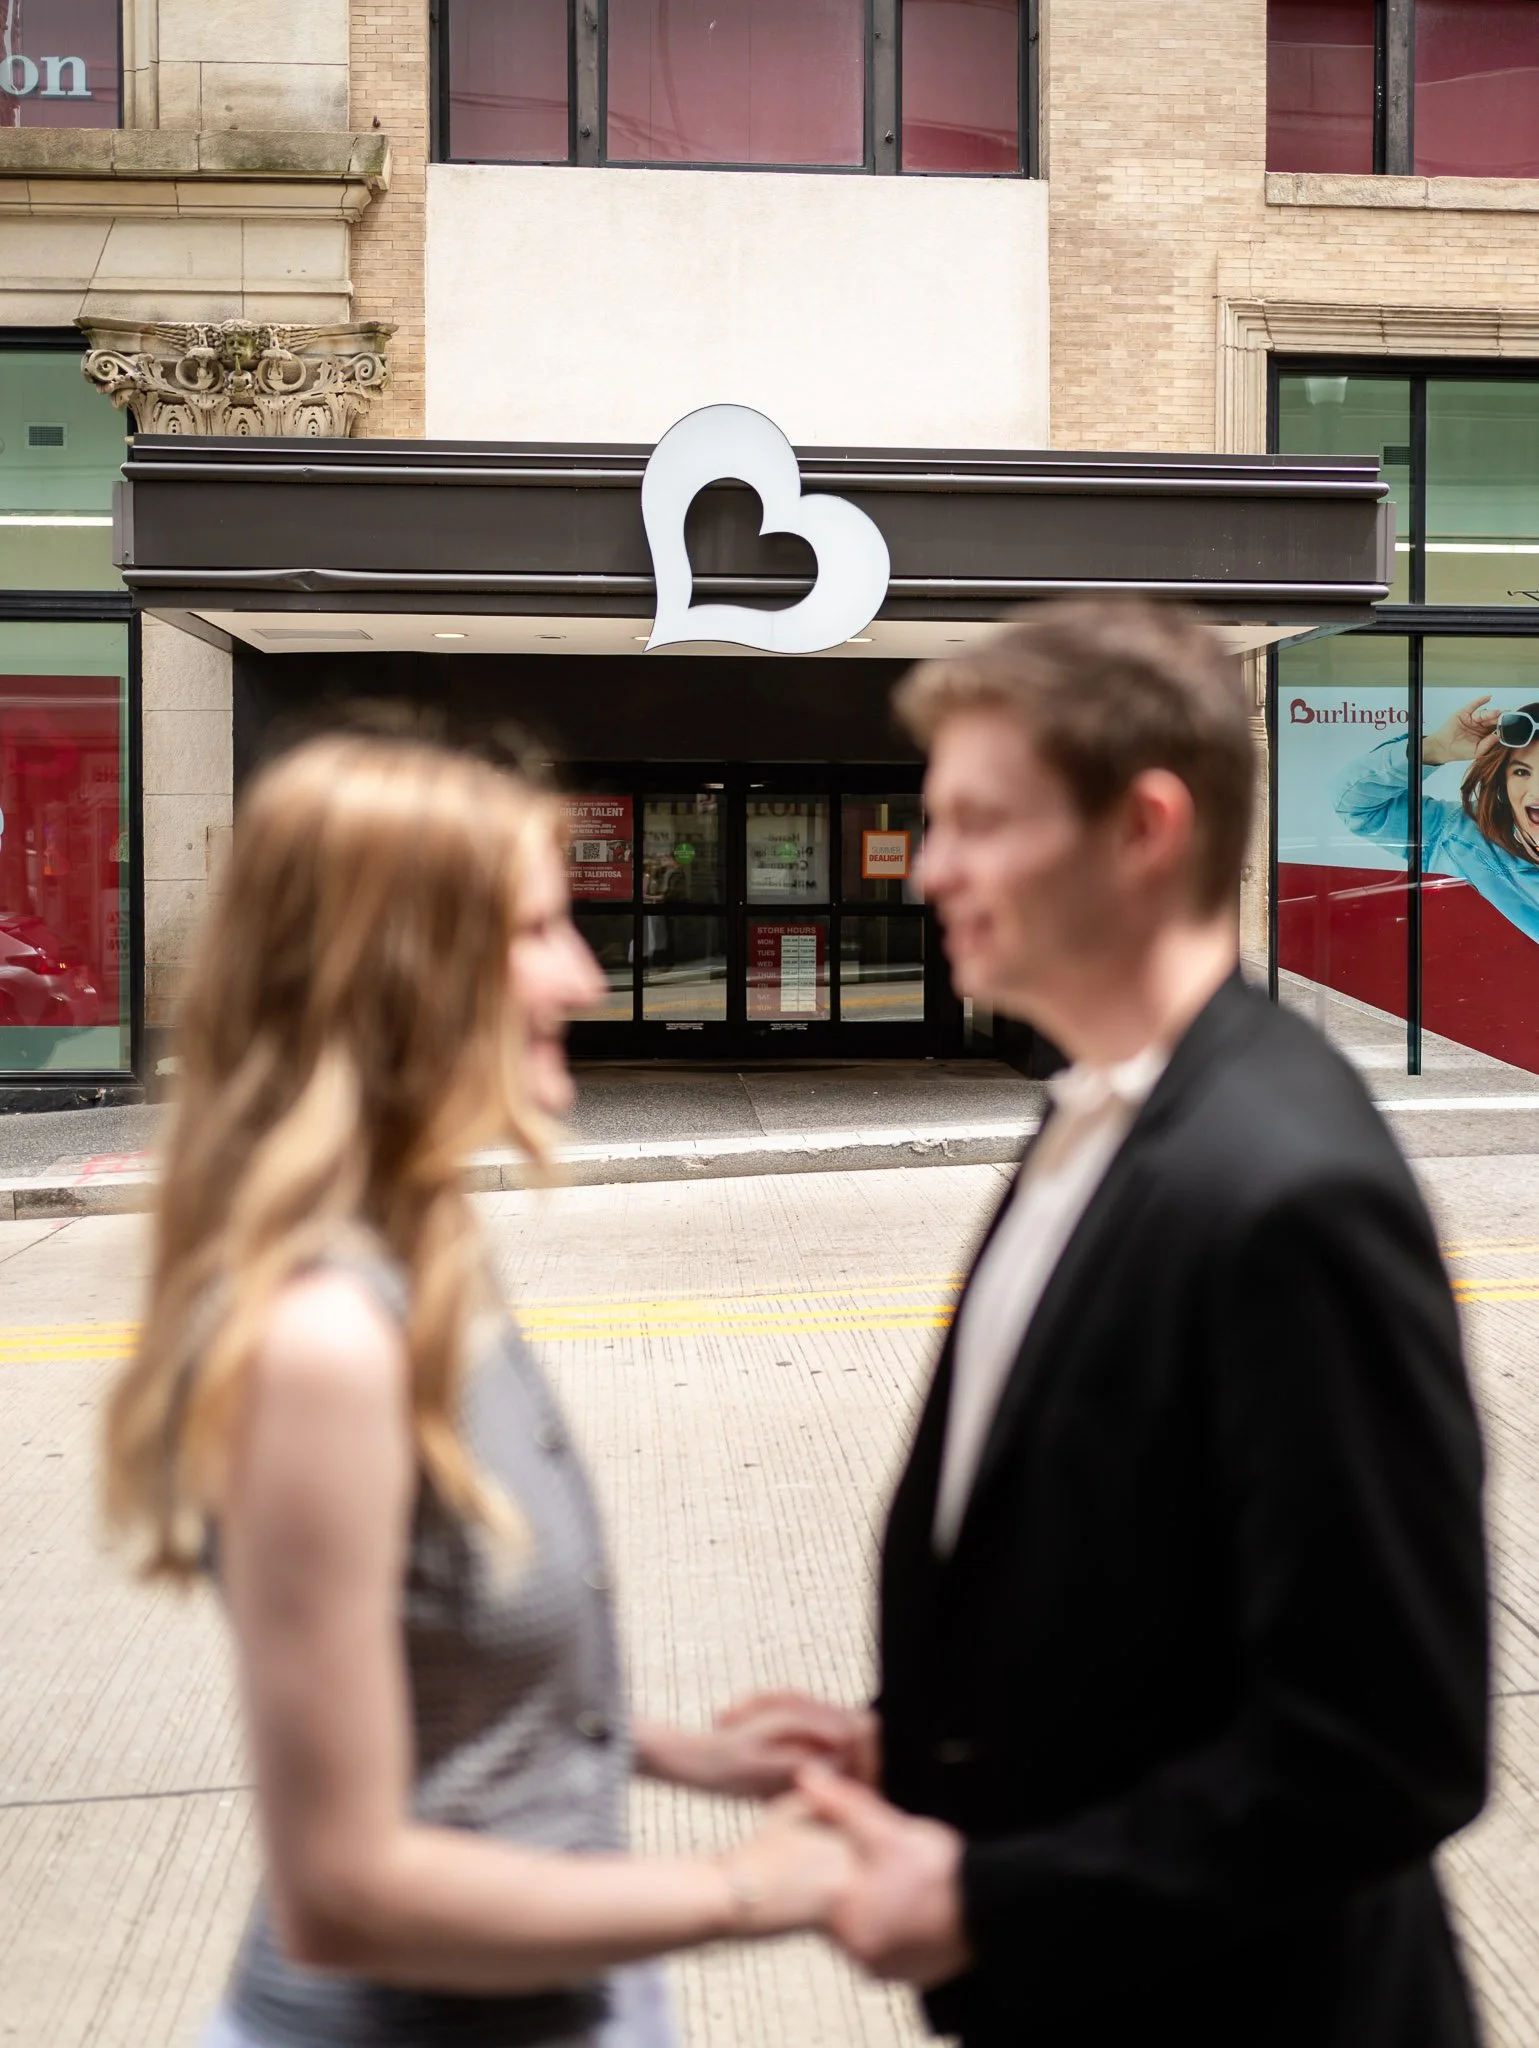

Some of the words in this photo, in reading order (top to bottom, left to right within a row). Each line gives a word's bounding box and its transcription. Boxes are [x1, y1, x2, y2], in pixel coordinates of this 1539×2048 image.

[0, 55, 92, 97] on
[1290, 698, 1412, 731] Burlingto
[591, 807, 625, 817] TALENT
[871, 846, 901, 854] SUMMER
[868, 854, 904, 862] DEALIGHT
[584, 870, 622, 878] TALENTOSA
[757, 926, 785, 934] STORE
[787, 926, 817, 934] HOURS
